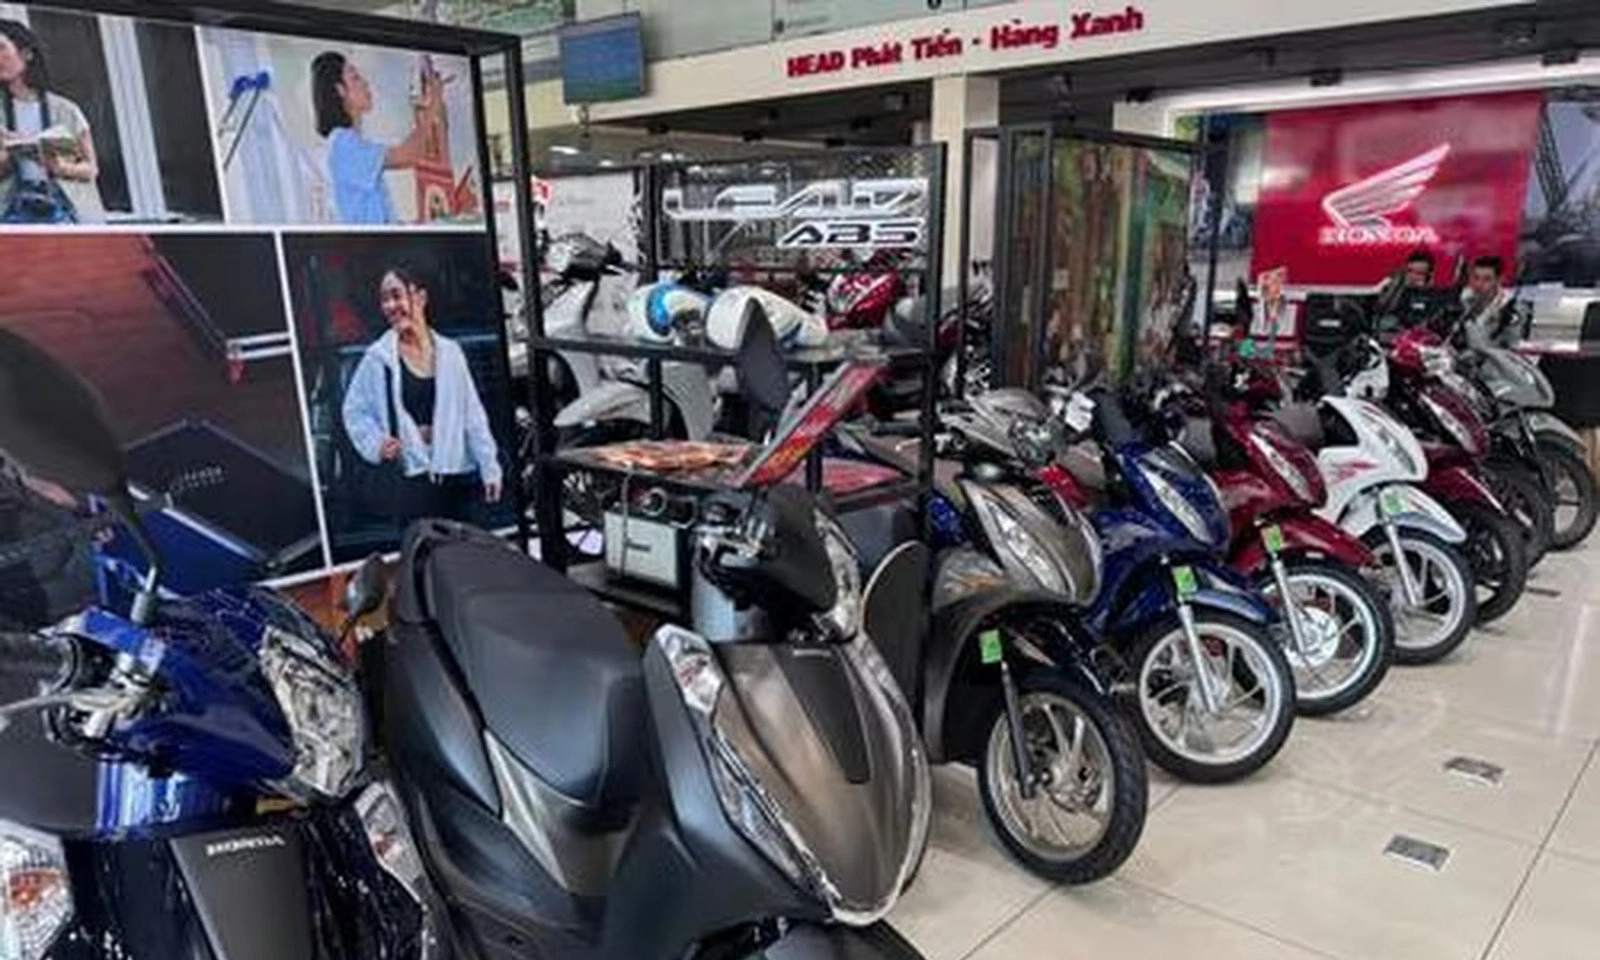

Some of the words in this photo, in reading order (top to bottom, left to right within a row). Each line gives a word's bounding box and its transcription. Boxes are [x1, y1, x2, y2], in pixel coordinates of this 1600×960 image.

[787, 50, 845, 77] HEAD
[851, 41, 903, 68] Phát
[991, 18, 1059, 51] Hàng
[1070, 6, 1143, 39] Xanh
[775, 217, 925, 248] ABS
[1319, 225, 1440, 245] HONDA
[205, 835, 286, 857] HONDA
